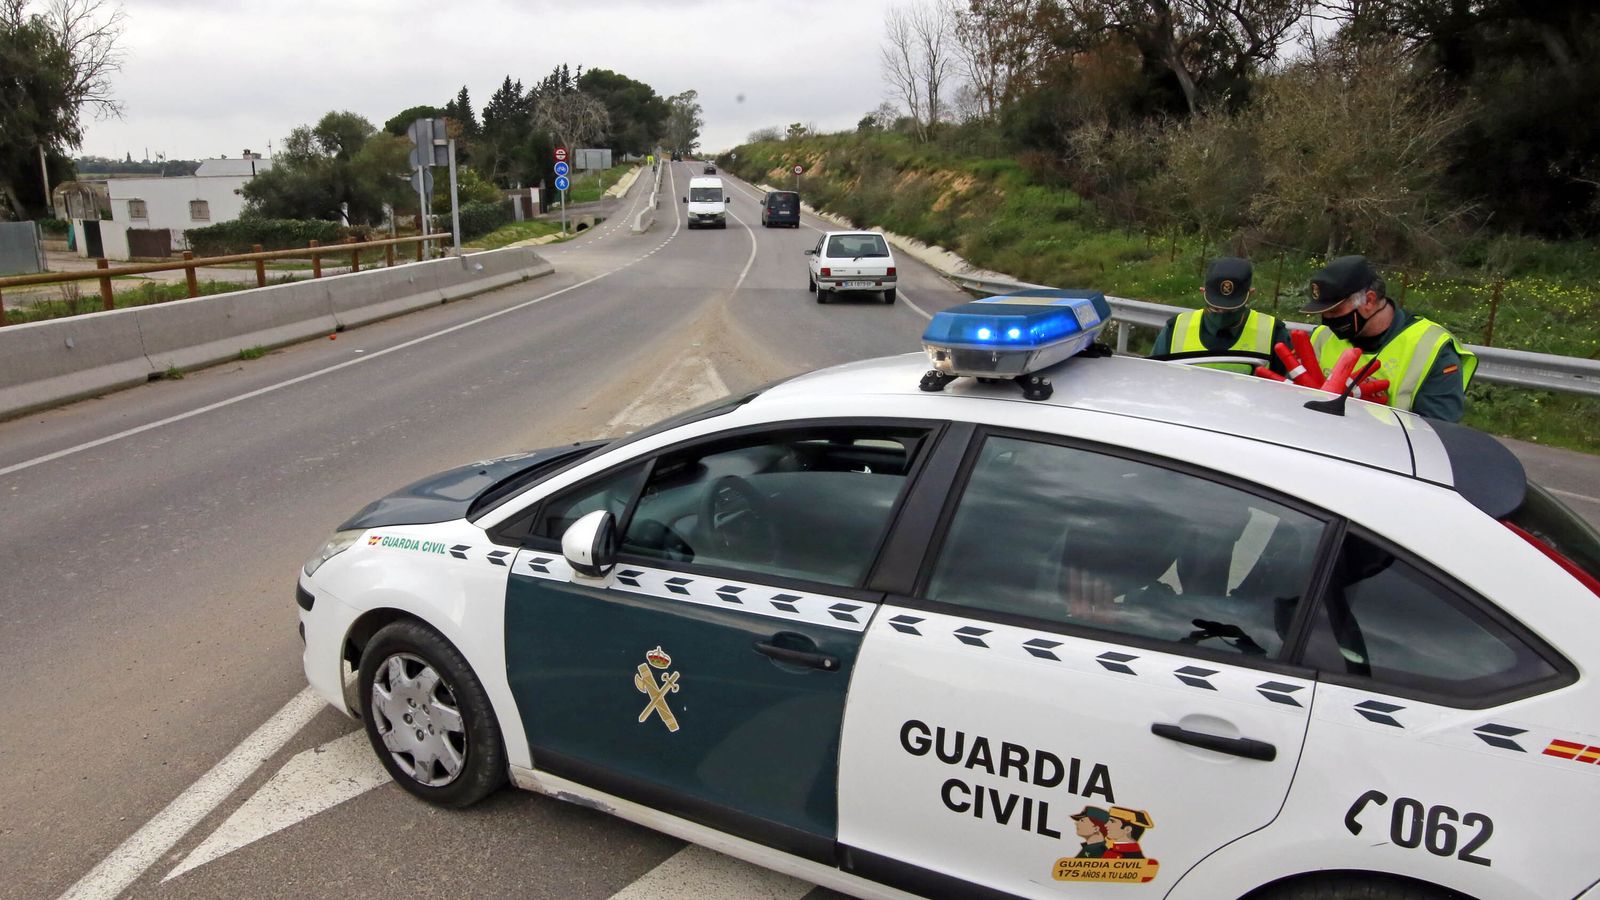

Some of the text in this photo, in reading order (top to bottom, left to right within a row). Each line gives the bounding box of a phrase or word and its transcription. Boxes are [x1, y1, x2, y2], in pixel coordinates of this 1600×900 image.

[382, 536, 446, 554] GUARDIA CIVIL
[900, 719, 1115, 804] GUARDIA
[941, 778, 1061, 840] CIVIL
[1390, 797, 1494, 867] 062
[1057, 869, 1080, 877] 175
[1081, 869, 1100, 878] AÑOS
[1108, 871, 1118, 879] TU
[1118, 871, 1138, 879] LADO
[1059, 860, 1142, 869] GUARDIA CIVIL
